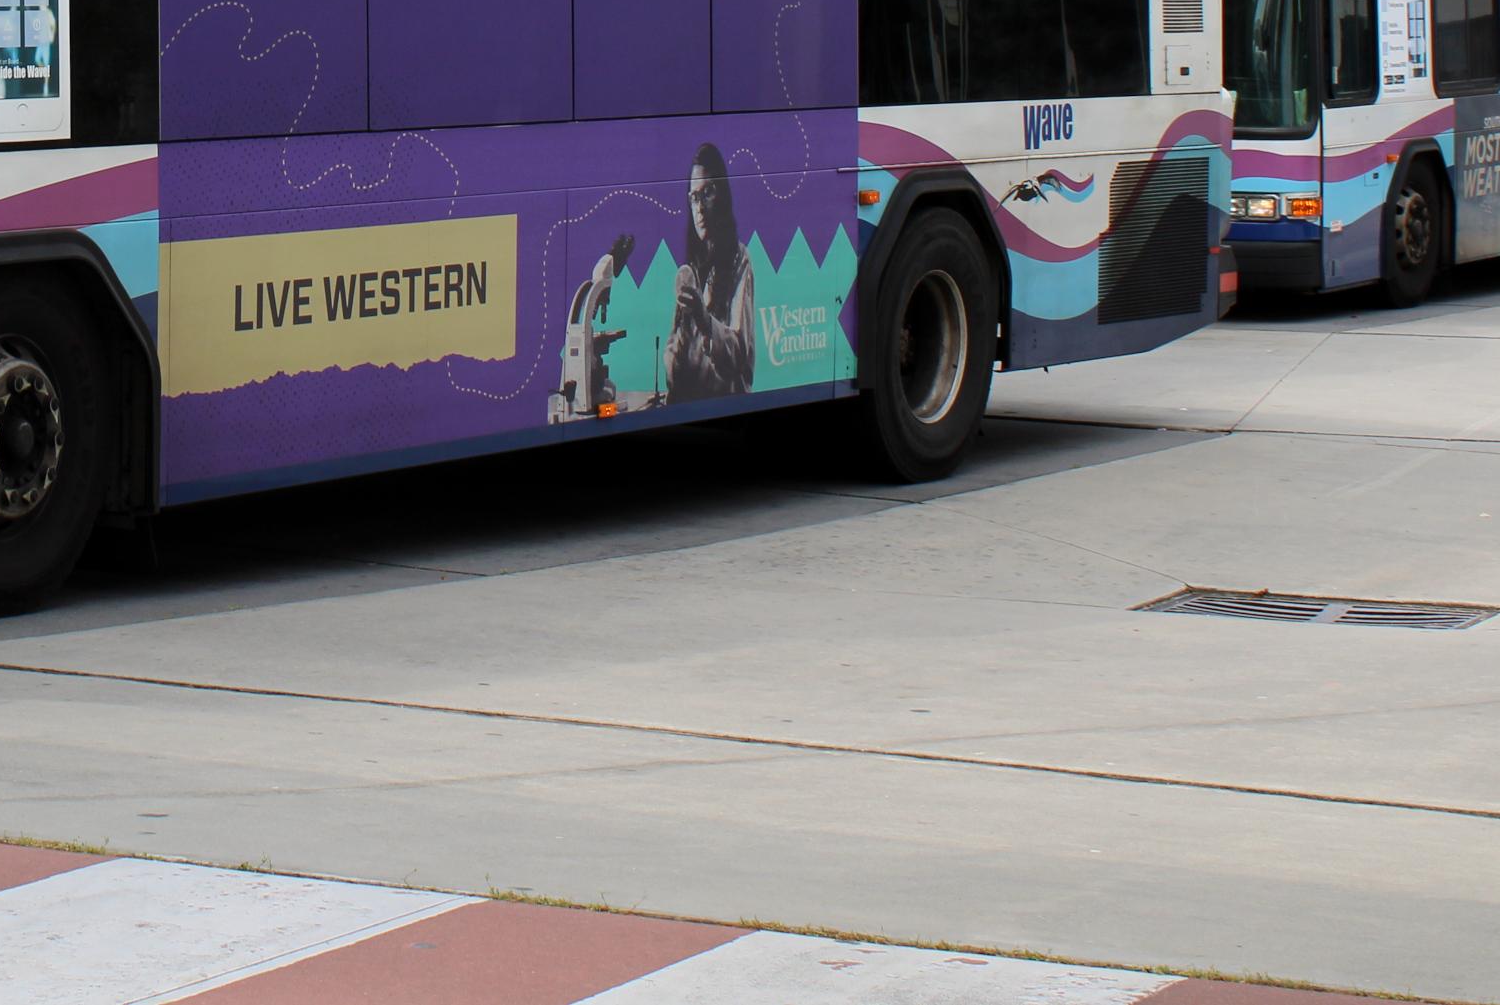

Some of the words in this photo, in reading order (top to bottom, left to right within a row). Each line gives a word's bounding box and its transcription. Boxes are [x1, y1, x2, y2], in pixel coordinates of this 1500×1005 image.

[13, 66, 27, 79] the
[234, 278, 312, 332] LIVE
[324, 261, 487, 322] WESTERN
[759, 305, 826, 347] Western
[768, 326, 827, 366] Carolina
